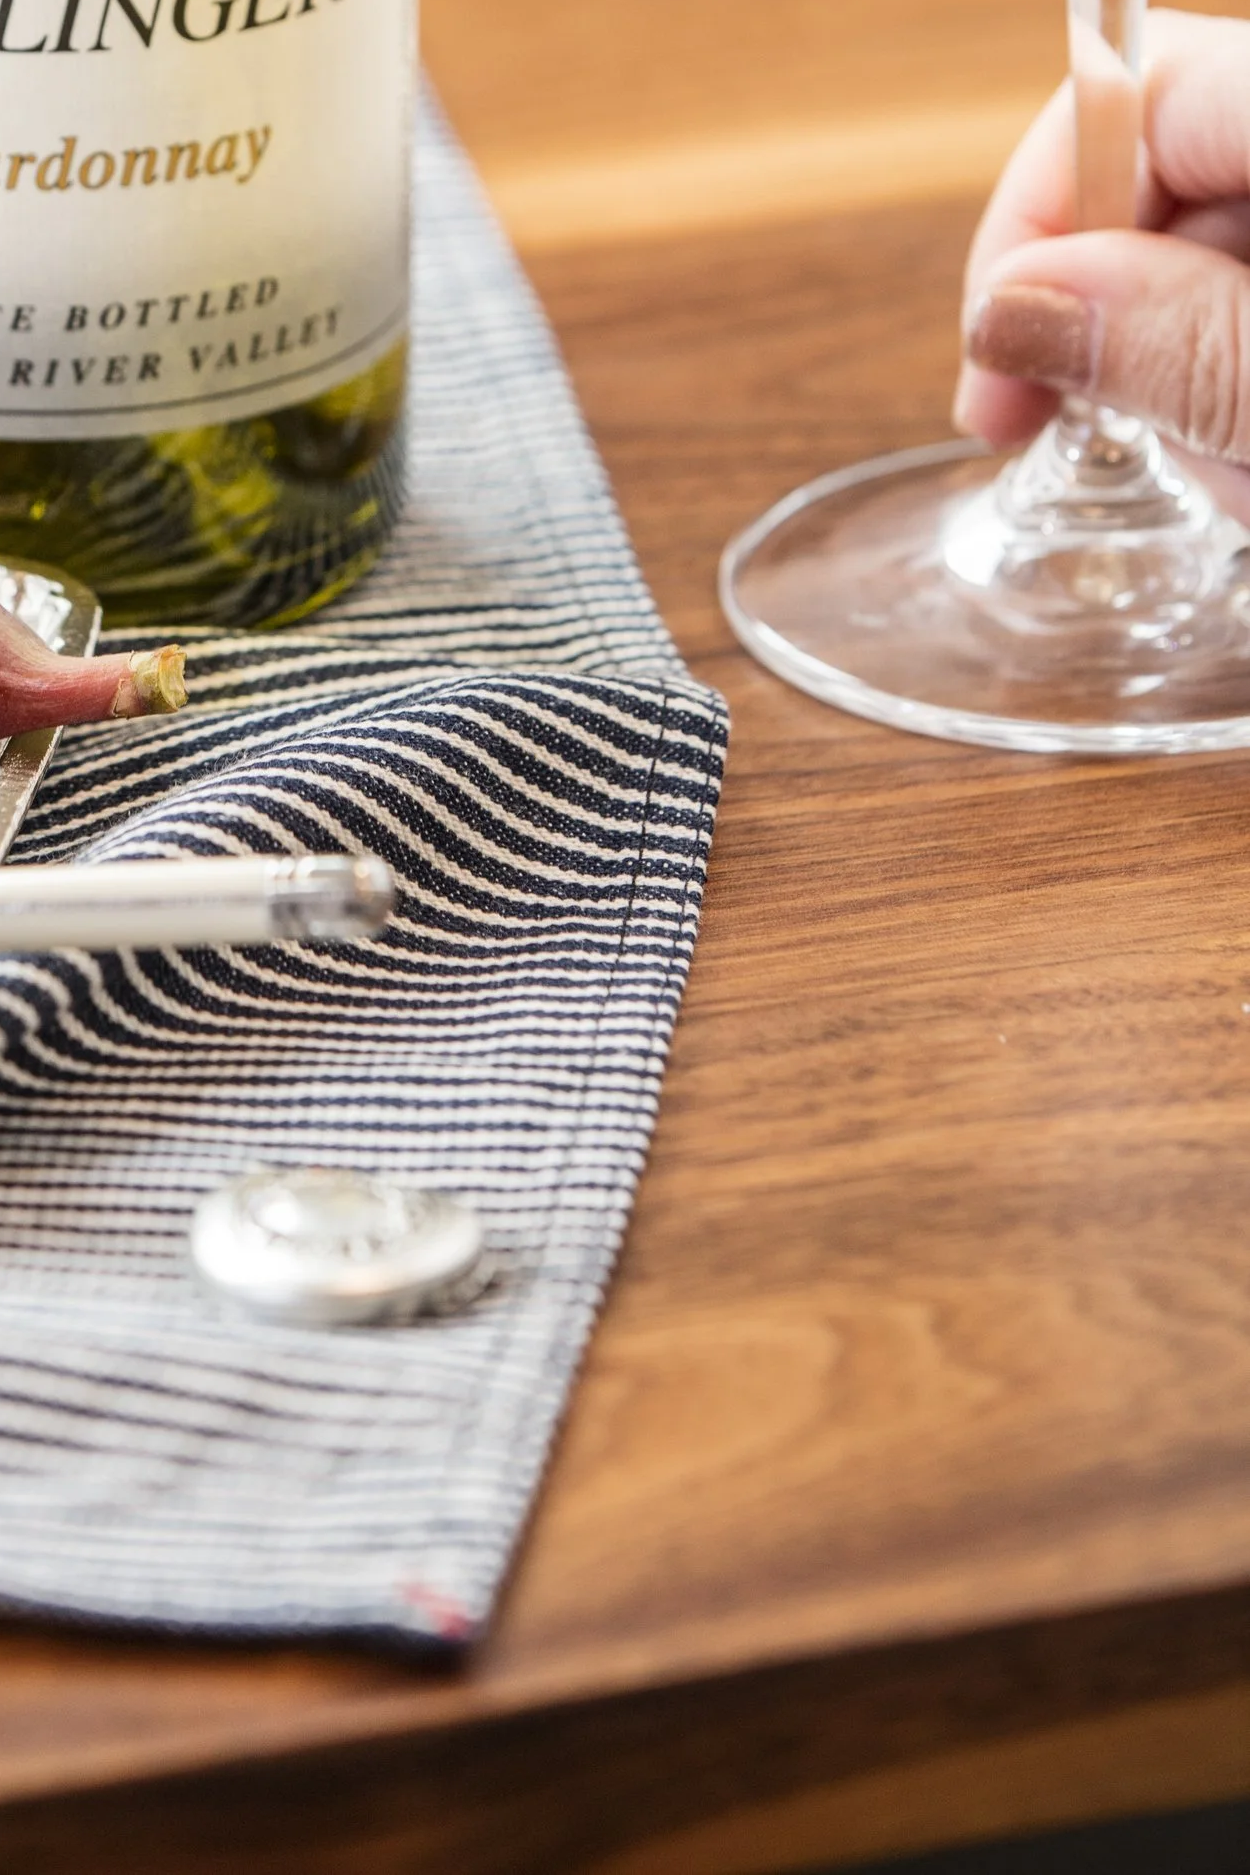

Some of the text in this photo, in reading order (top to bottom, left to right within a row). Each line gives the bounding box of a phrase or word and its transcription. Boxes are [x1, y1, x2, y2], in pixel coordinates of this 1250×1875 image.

[64, 276, 280, 331] BOTTLED
[8, 354, 162, 387] RIVER
[188, 306, 344, 373] VALLEY
